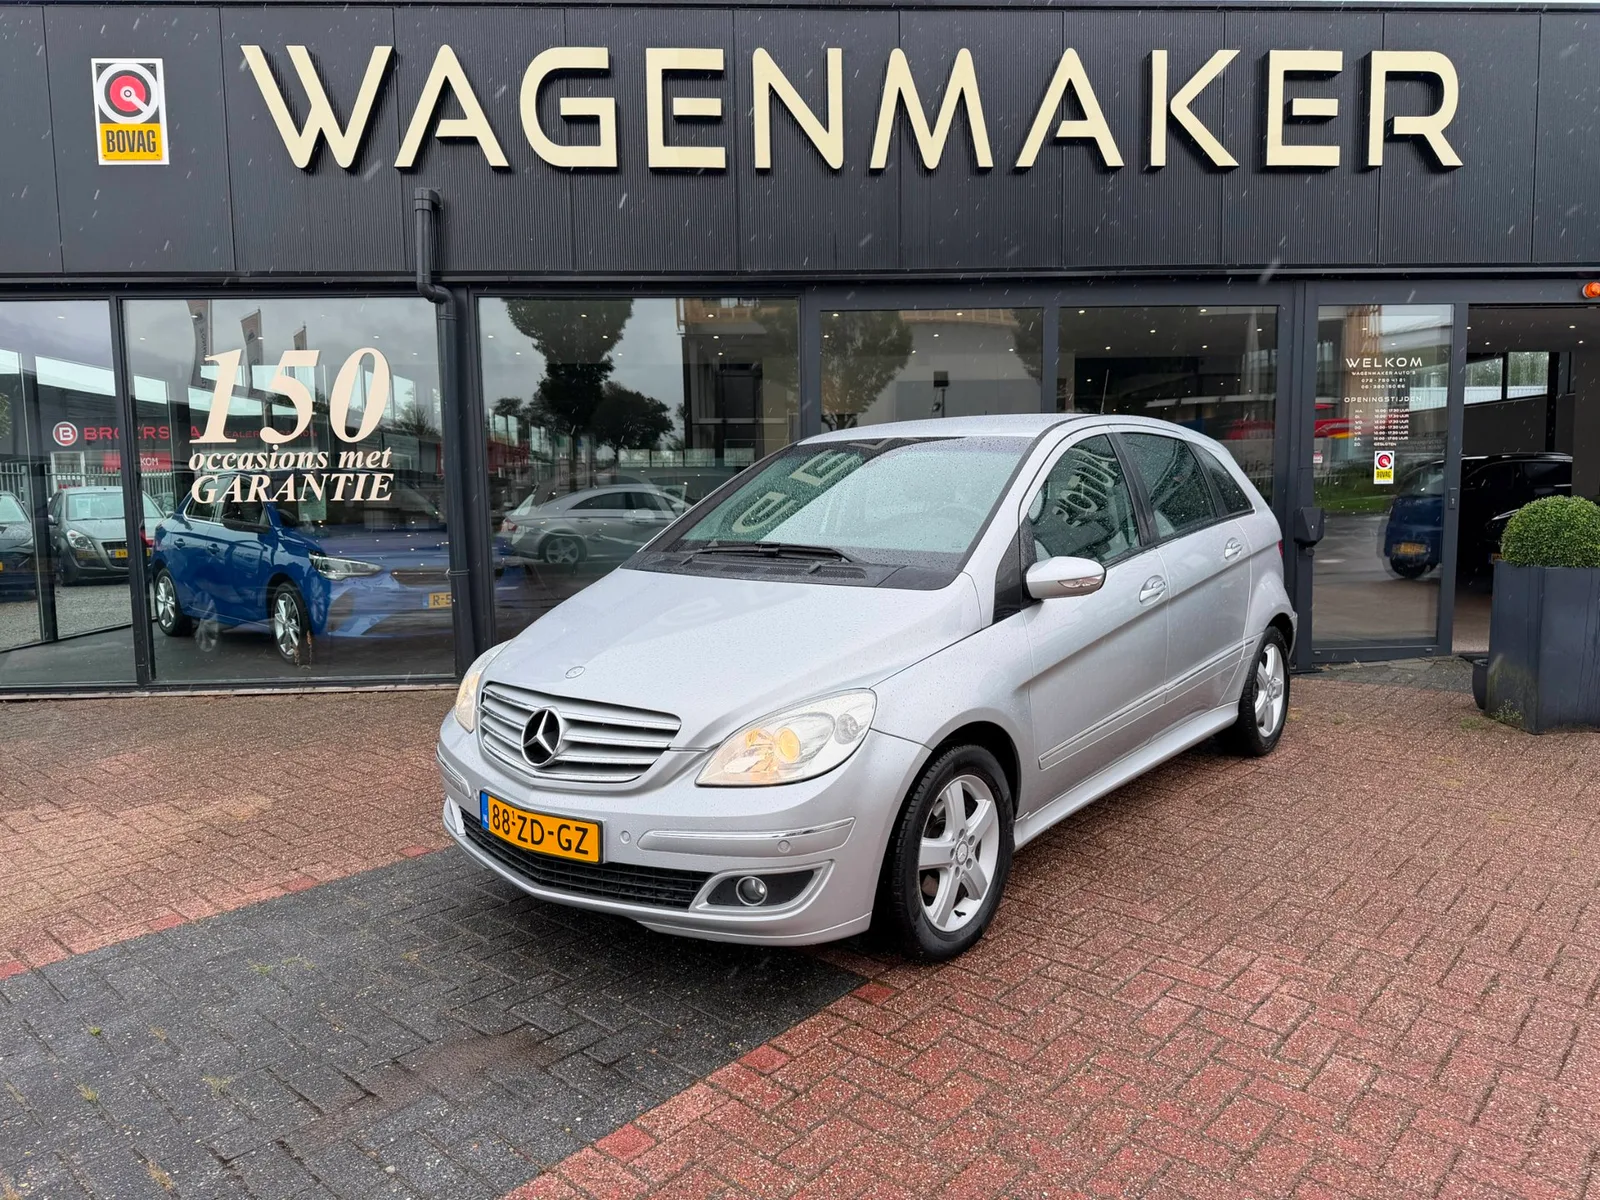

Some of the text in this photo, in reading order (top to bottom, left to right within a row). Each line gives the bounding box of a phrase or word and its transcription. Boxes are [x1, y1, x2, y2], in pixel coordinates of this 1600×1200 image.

[240, 44, 1464, 170] WAGENMAKER
[106, 129, 156, 153] BOVAG
[1345, 357, 1423, 368] WELKOM
[189, 347, 391, 444] 150
[1344, 395, 1422, 403] OPENINGSTIJDEN
[188, 444, 392, 471] occasions met
[191, 473, 395, 505] GARANTIE
[492, 803, 589, 856] 88-ZD-GZ
